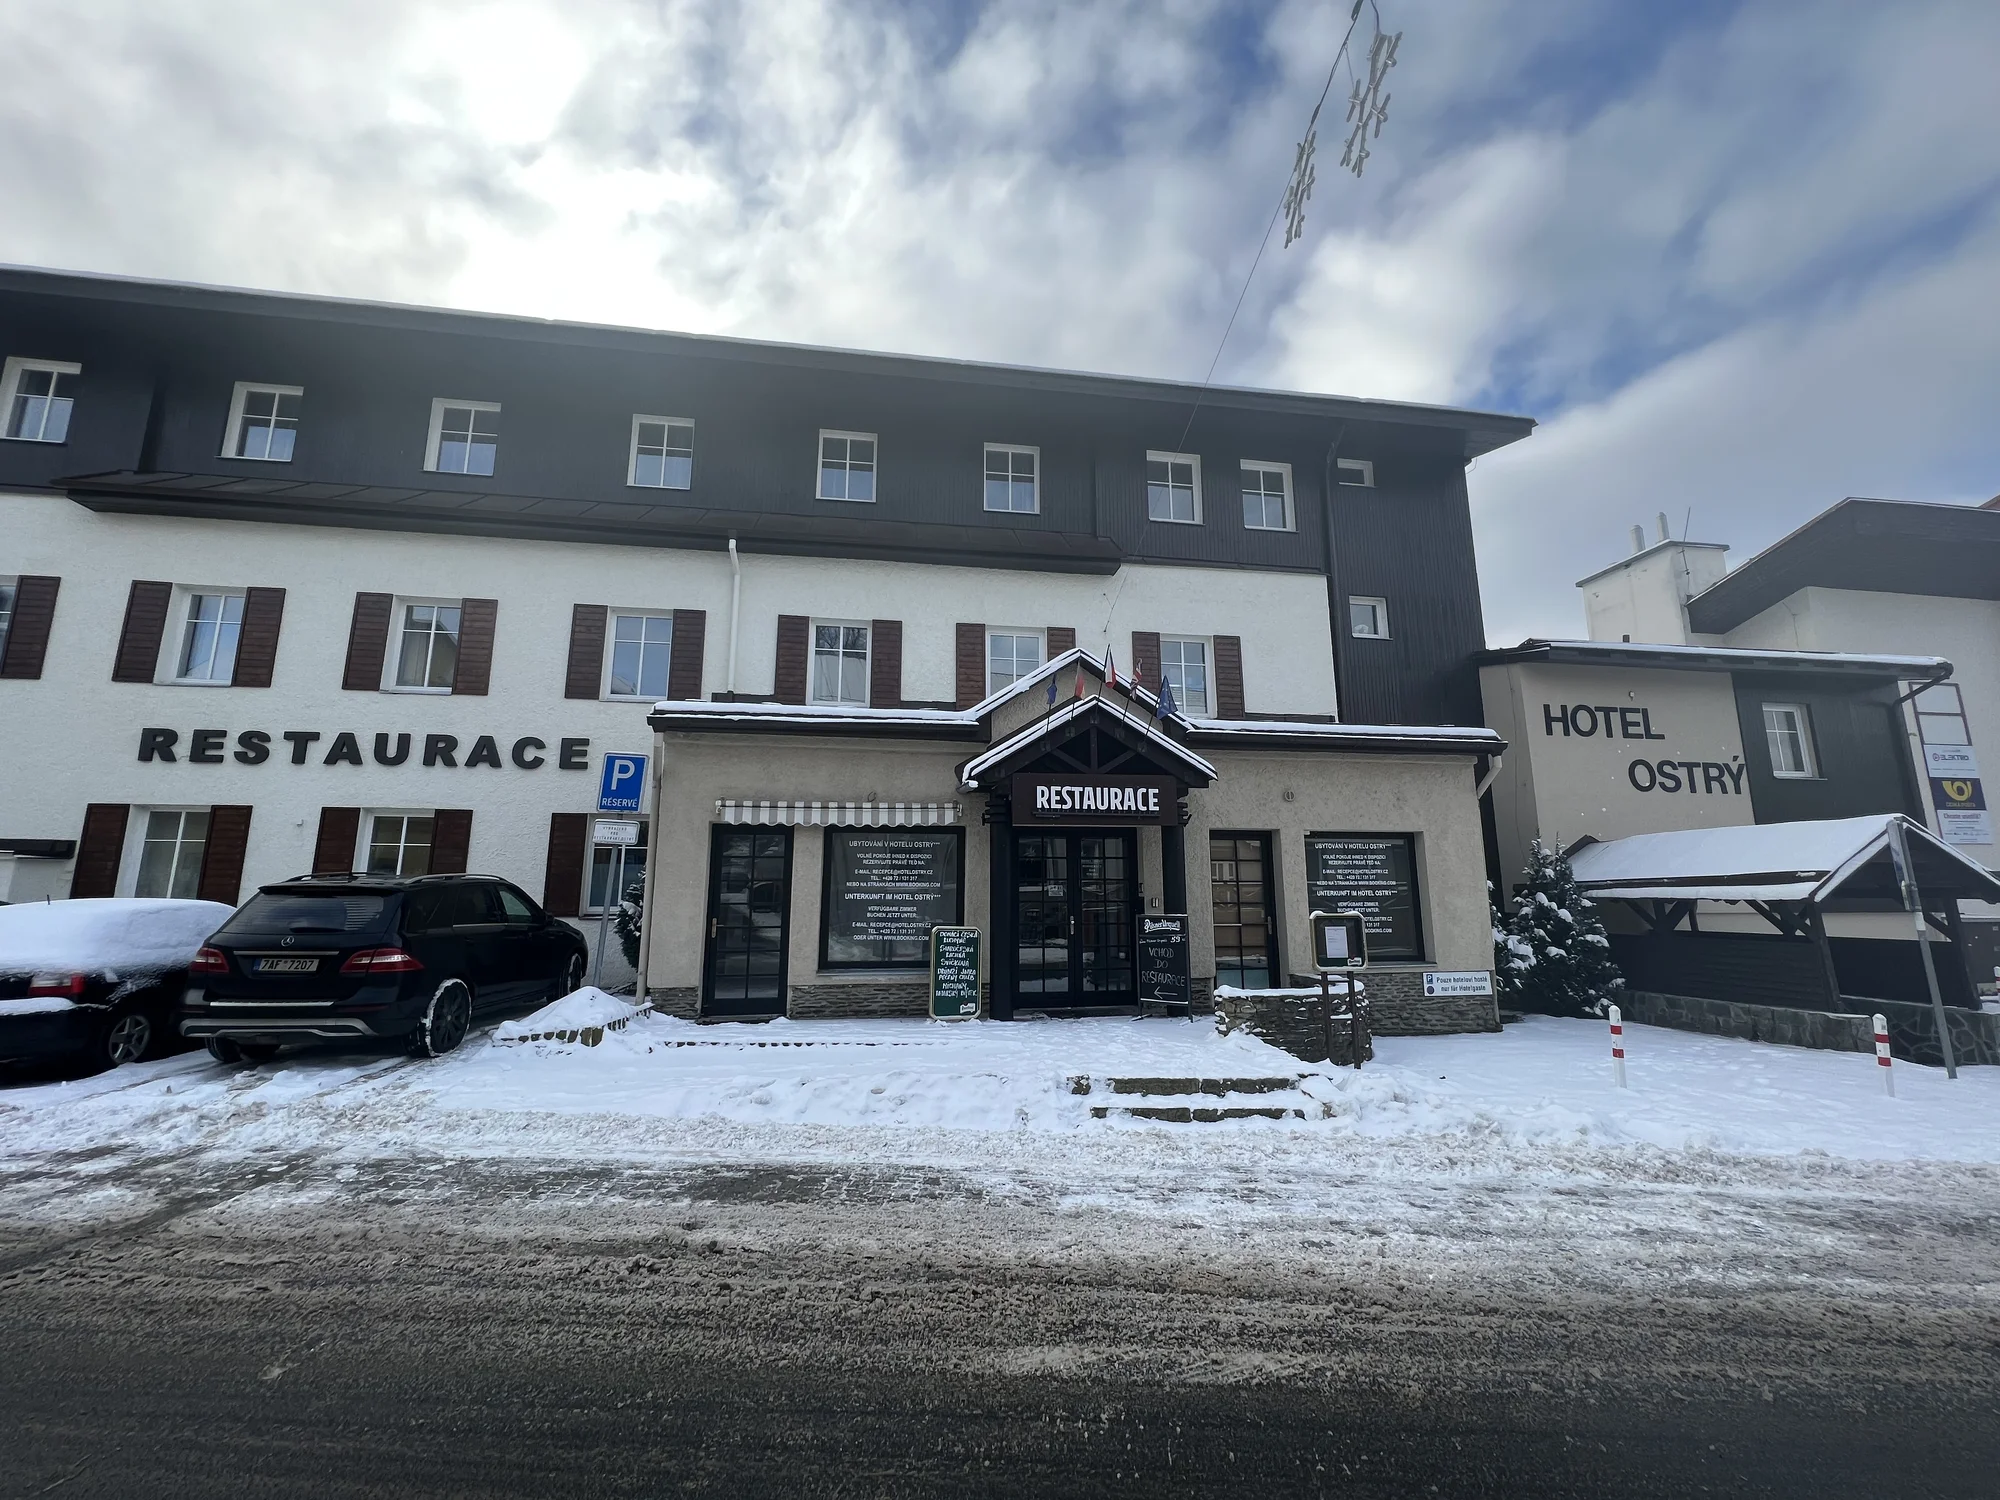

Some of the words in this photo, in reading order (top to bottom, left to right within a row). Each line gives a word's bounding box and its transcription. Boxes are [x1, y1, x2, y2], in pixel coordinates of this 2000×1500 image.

[1543, 704, 1665, 740] HOTEL
[137, 727, 590, 770] RESTAURACE
[610, 760, 635, 790] P
[1628, 756, 1745, 794] OSTRÝ
[602, 797, 638, 808] RÉSERVÉ
[1036, 786, 1160, 811] RESTAURACE
[1148, 947, 1174, 958] VCHOD
[262, 960, 282, 970] 7AF
[288, 961, 314, 970] 7207
[1153, 959, 1168, 968] DO
[1142, 971, 1186, 987] RESTAURACE
